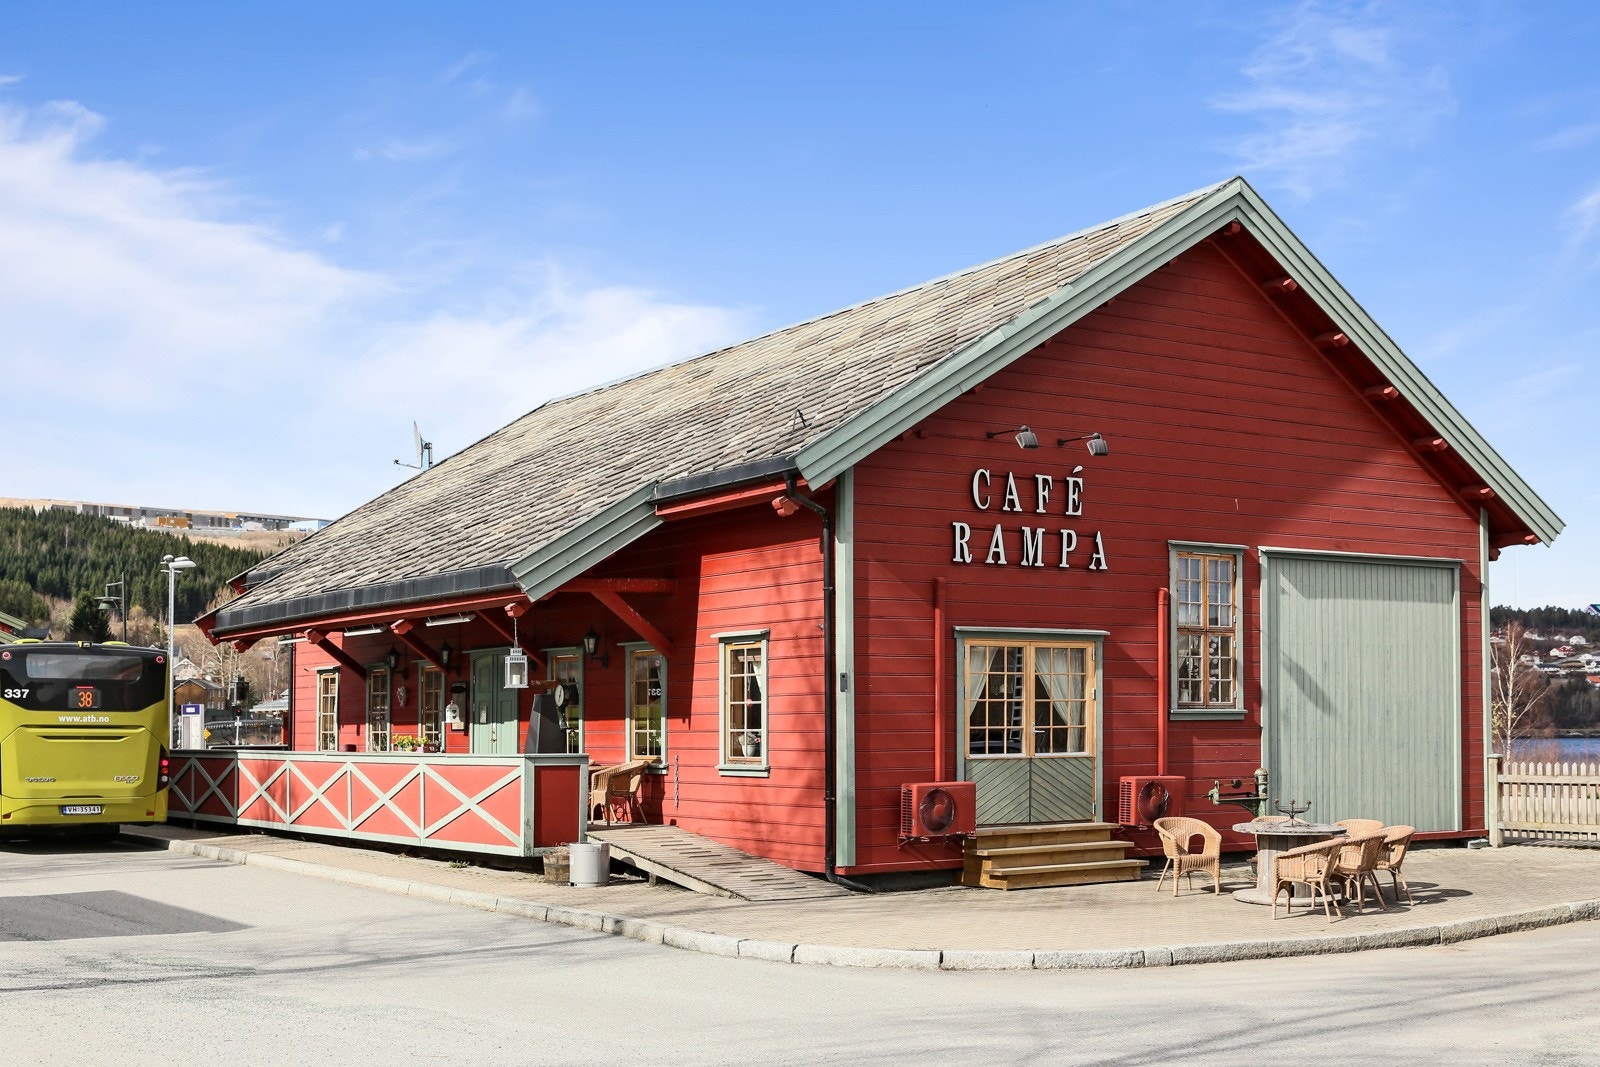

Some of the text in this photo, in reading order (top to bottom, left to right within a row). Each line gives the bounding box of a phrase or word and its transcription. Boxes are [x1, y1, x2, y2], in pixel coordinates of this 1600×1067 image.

[972, 465, 1083, 516] CAFÉ
[952, 521, 1108, 570] RAMPA
[4, 688, 30, 699] 337
[78, 691, 93, 708] 38
[58, 715, 110, 723] www.atb.no
